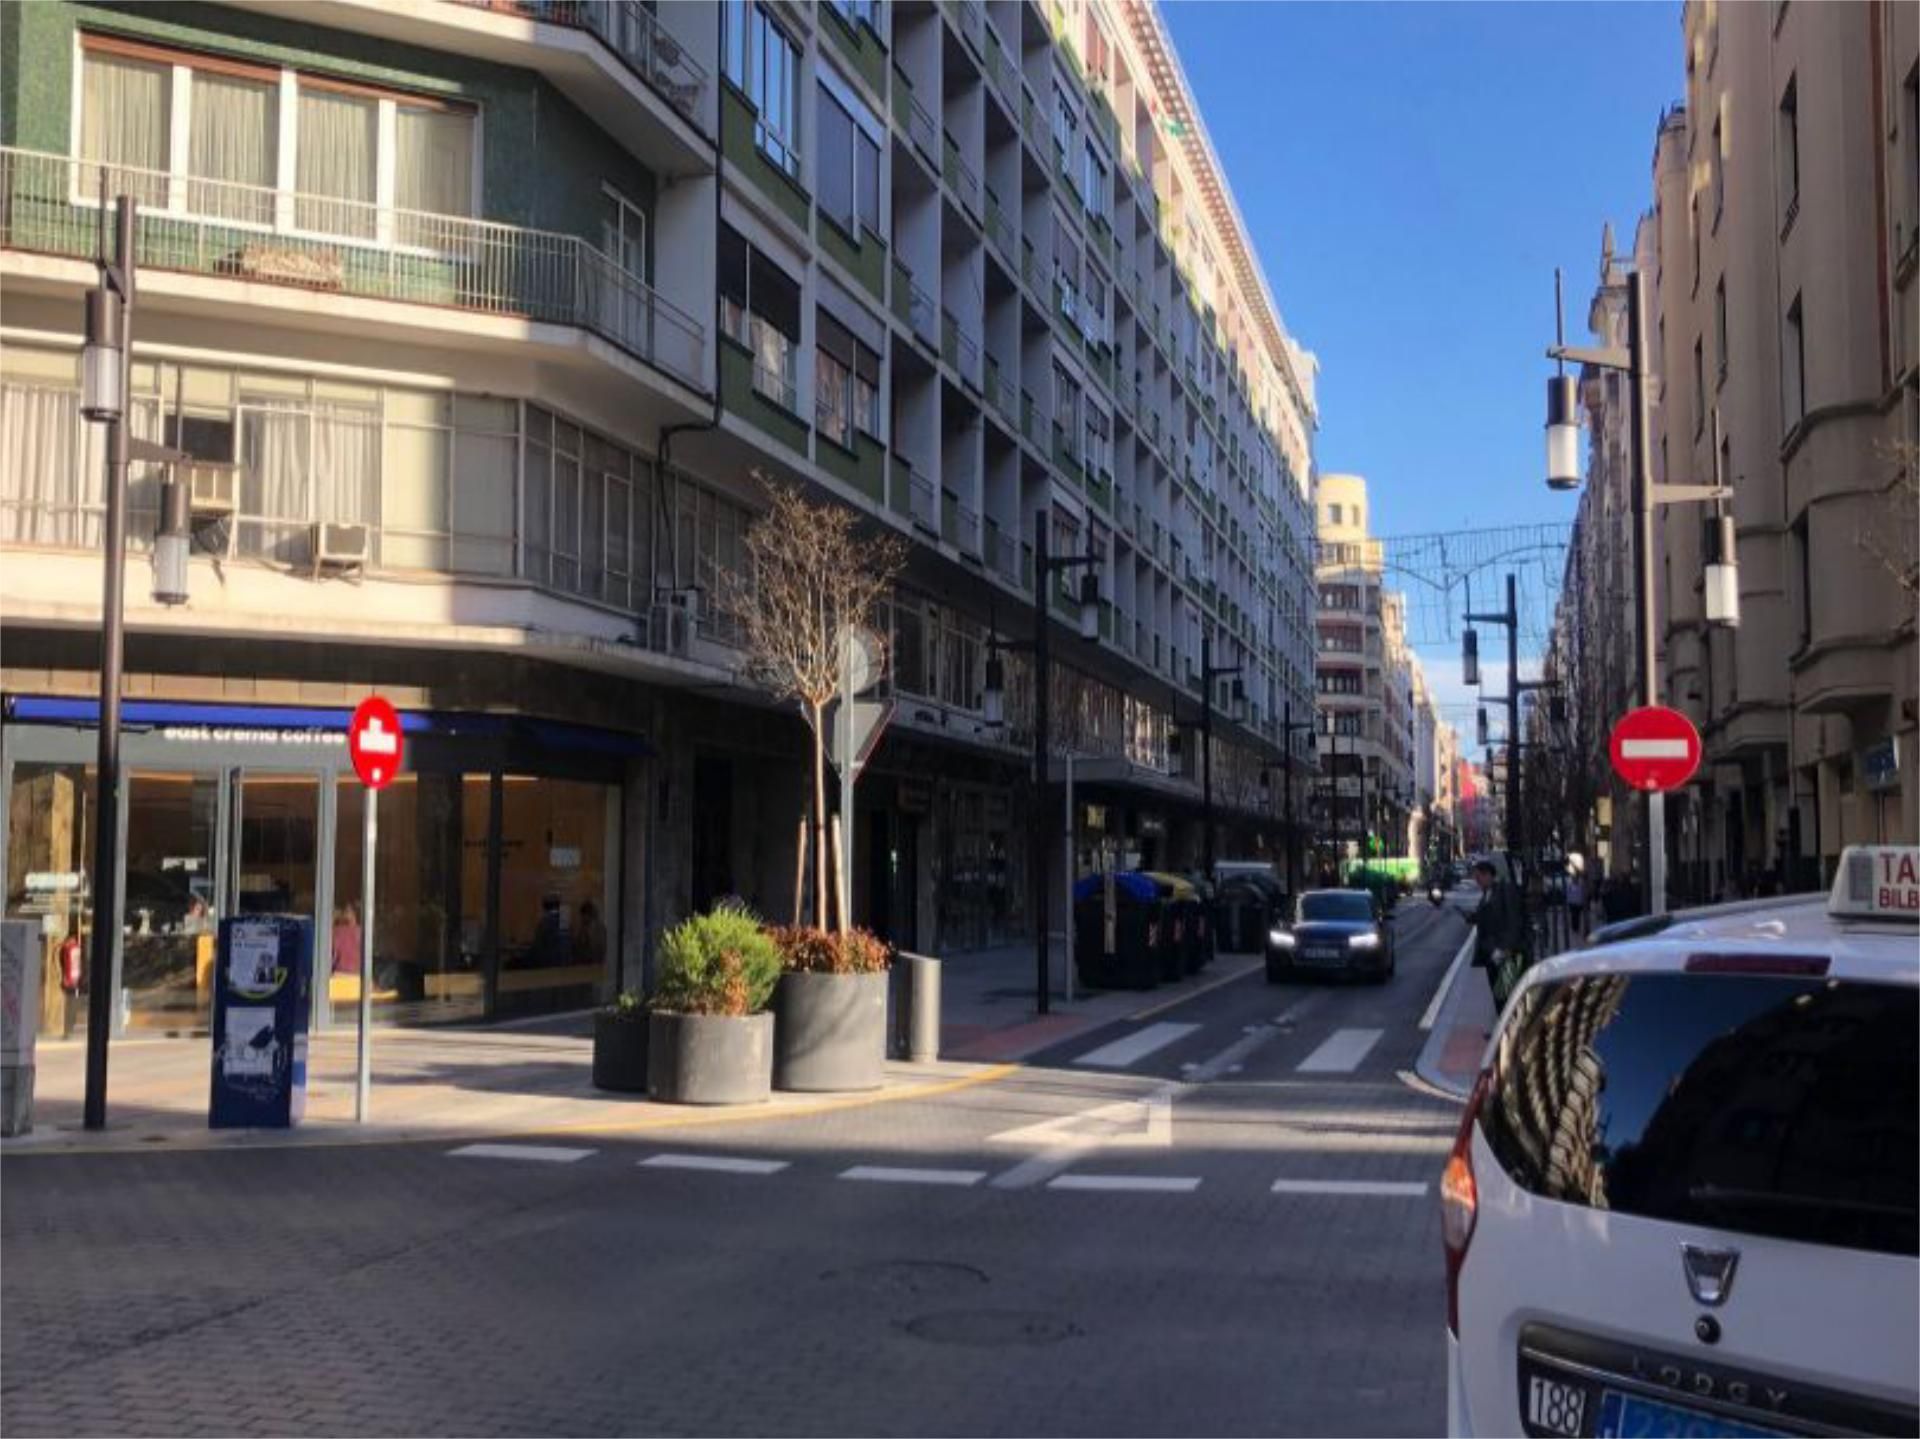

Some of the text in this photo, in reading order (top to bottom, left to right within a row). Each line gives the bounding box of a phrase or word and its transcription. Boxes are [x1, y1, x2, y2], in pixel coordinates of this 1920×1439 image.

[164, 725, 210, 741] east
[212, 727, 278, 743] crema
[1879, 853, 1919, 884] TA
[1535, 1380, 1581, 1433] 188
